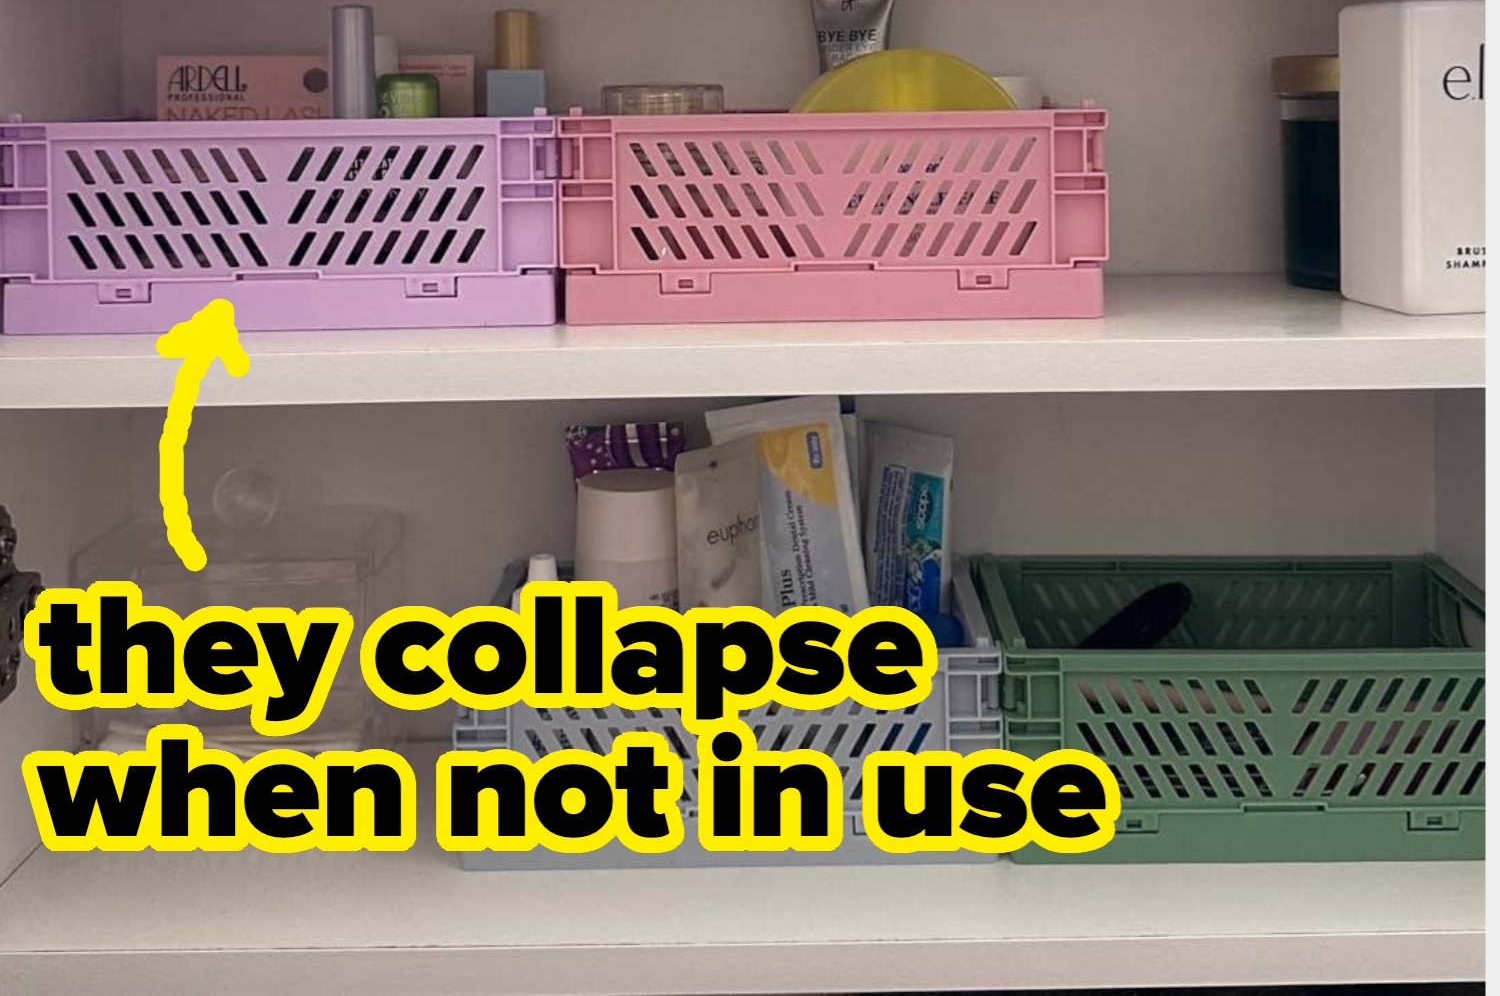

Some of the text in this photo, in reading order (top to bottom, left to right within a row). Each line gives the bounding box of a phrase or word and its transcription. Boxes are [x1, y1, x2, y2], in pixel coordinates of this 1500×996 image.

[818, 29, 877, 43] BYE BYE
[168, 64, 246, 92] ARDELL
[168, 93, 246, 102] PROFESSIONAL
[781, 569, 794, 607] Plus
